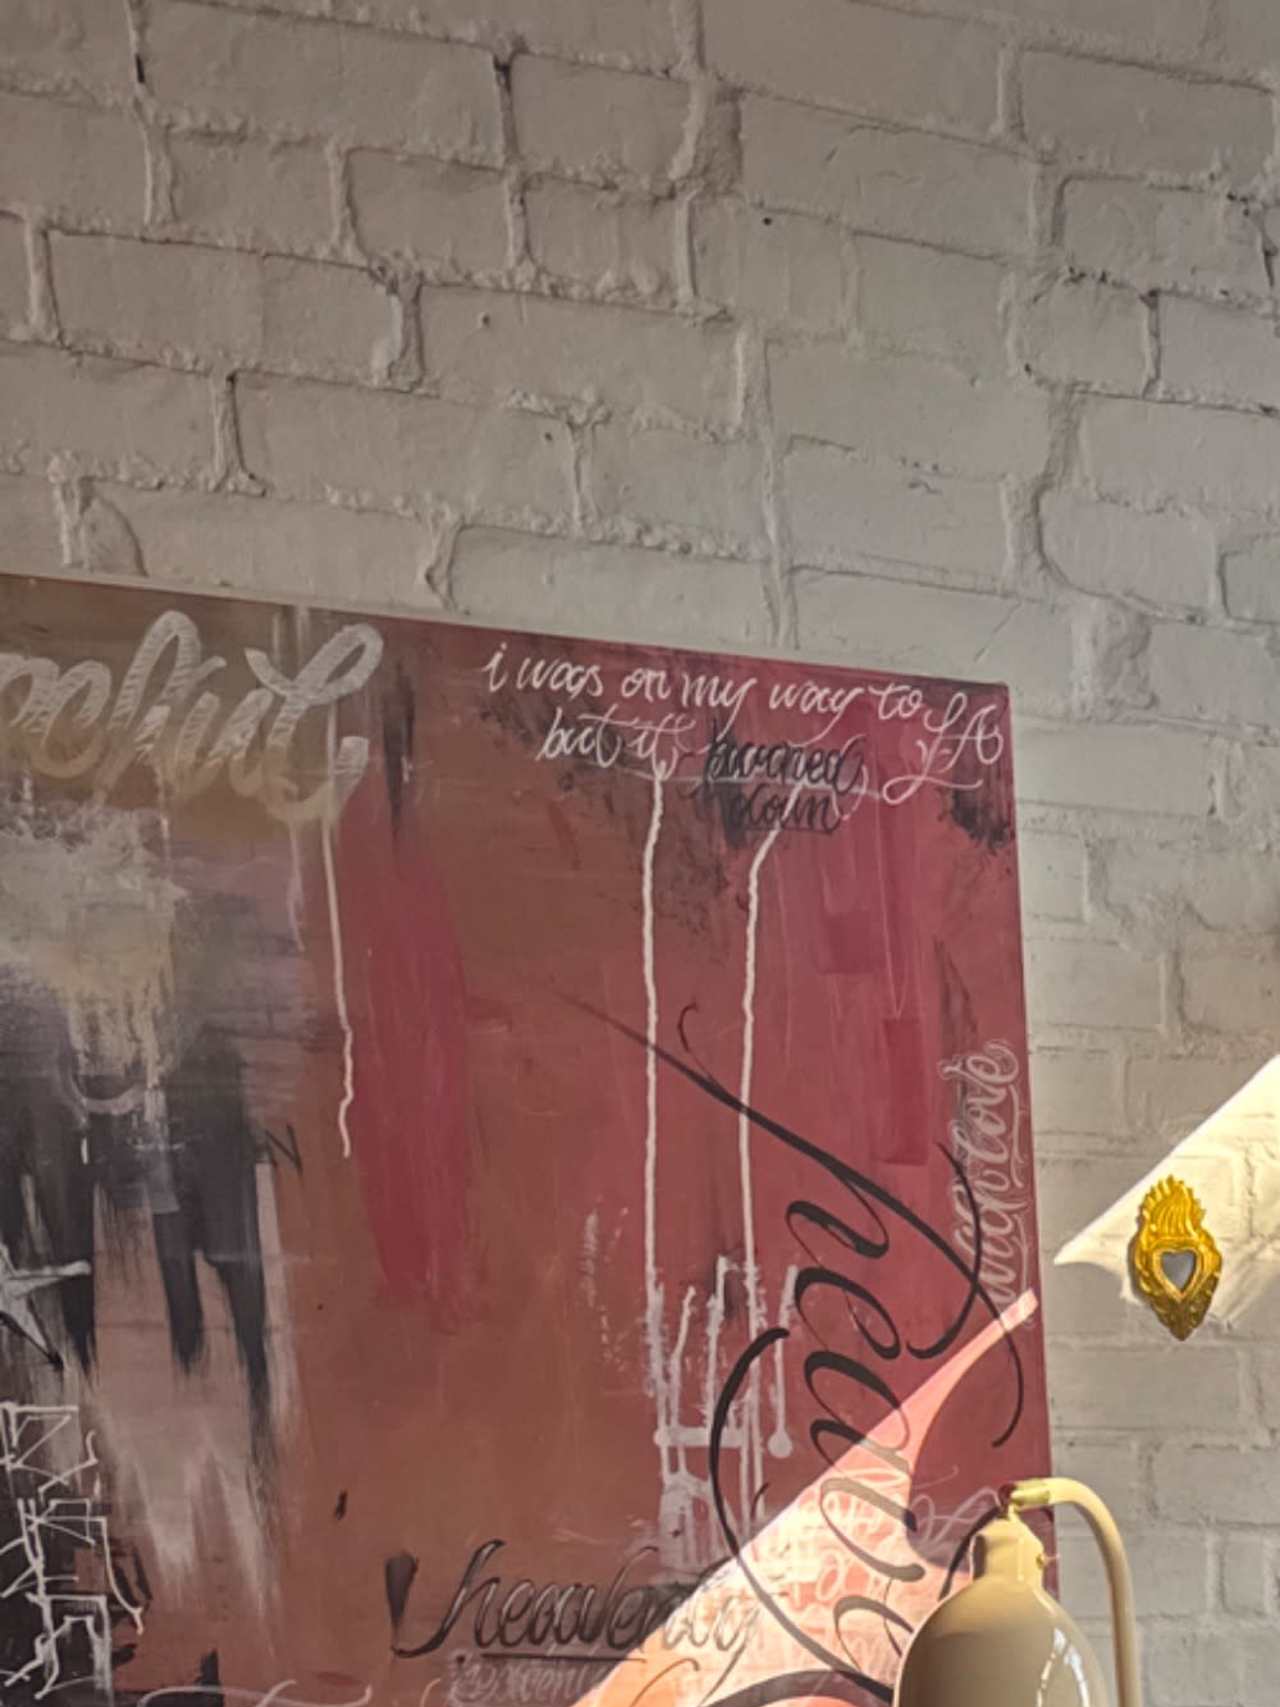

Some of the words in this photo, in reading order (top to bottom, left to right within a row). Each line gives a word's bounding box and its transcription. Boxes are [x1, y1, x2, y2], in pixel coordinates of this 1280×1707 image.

[482, 643, 508, 693] i
[516, 658, 603, 702] was
[620, 669, 671, 701] on
[684, 672, 758, 752] my
[770, 681, 867, 746] way
[867, 685, 925, 721] to
[537, 705, 625, 769] but
[624, 711, 697, 782] it
[938, 1040, 1020, 1162] love
[385, 1539, 762, 1660] heavenly
